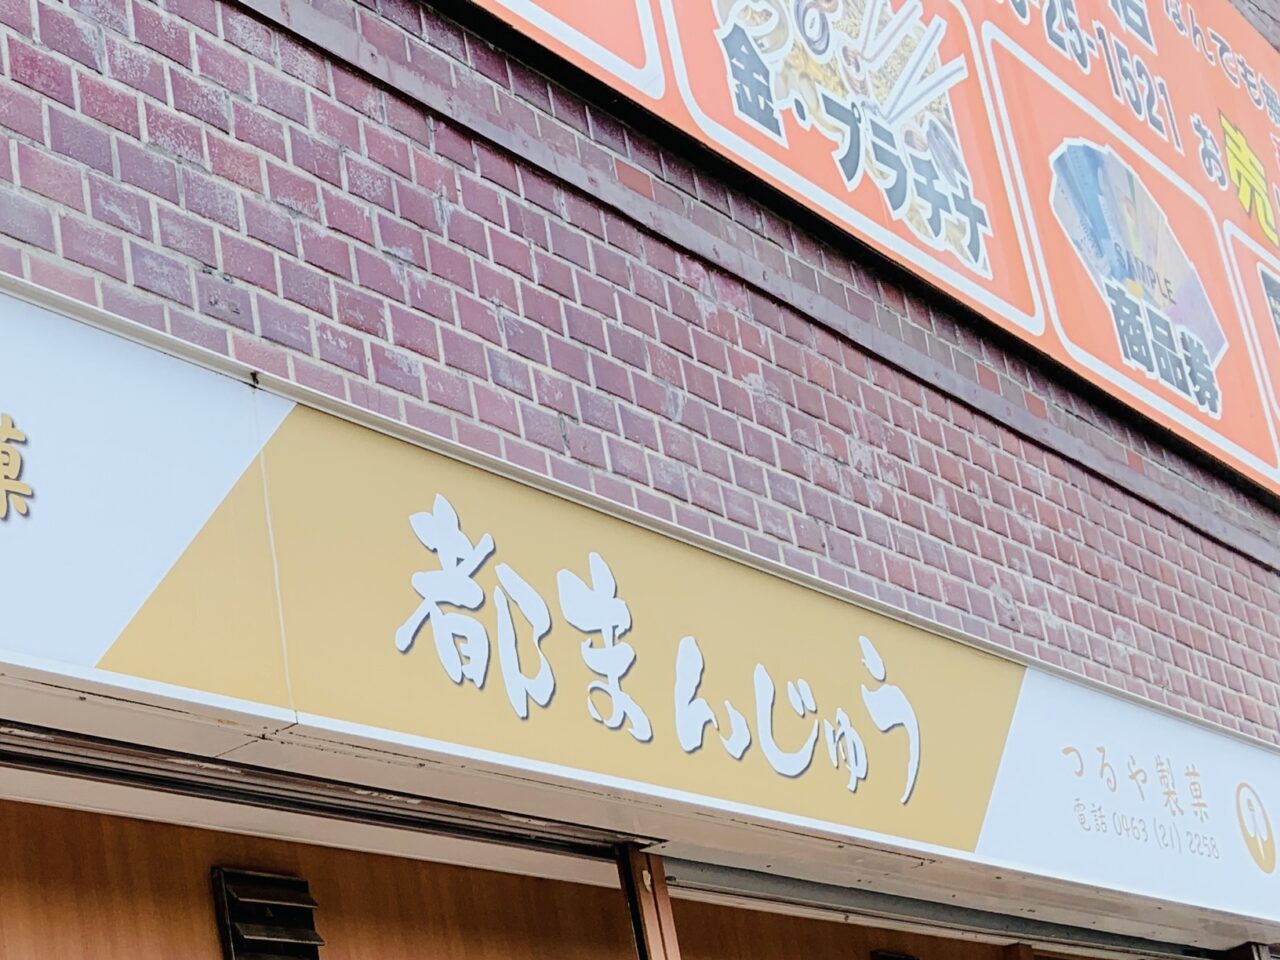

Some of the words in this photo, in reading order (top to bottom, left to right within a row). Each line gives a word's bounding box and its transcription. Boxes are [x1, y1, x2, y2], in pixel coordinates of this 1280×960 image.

[1104, 279, 1219, 414] 商品券
[395, 493, 920, 805] 都まんじゅう
[1062, 746, 1208, 823] つるや製菓
